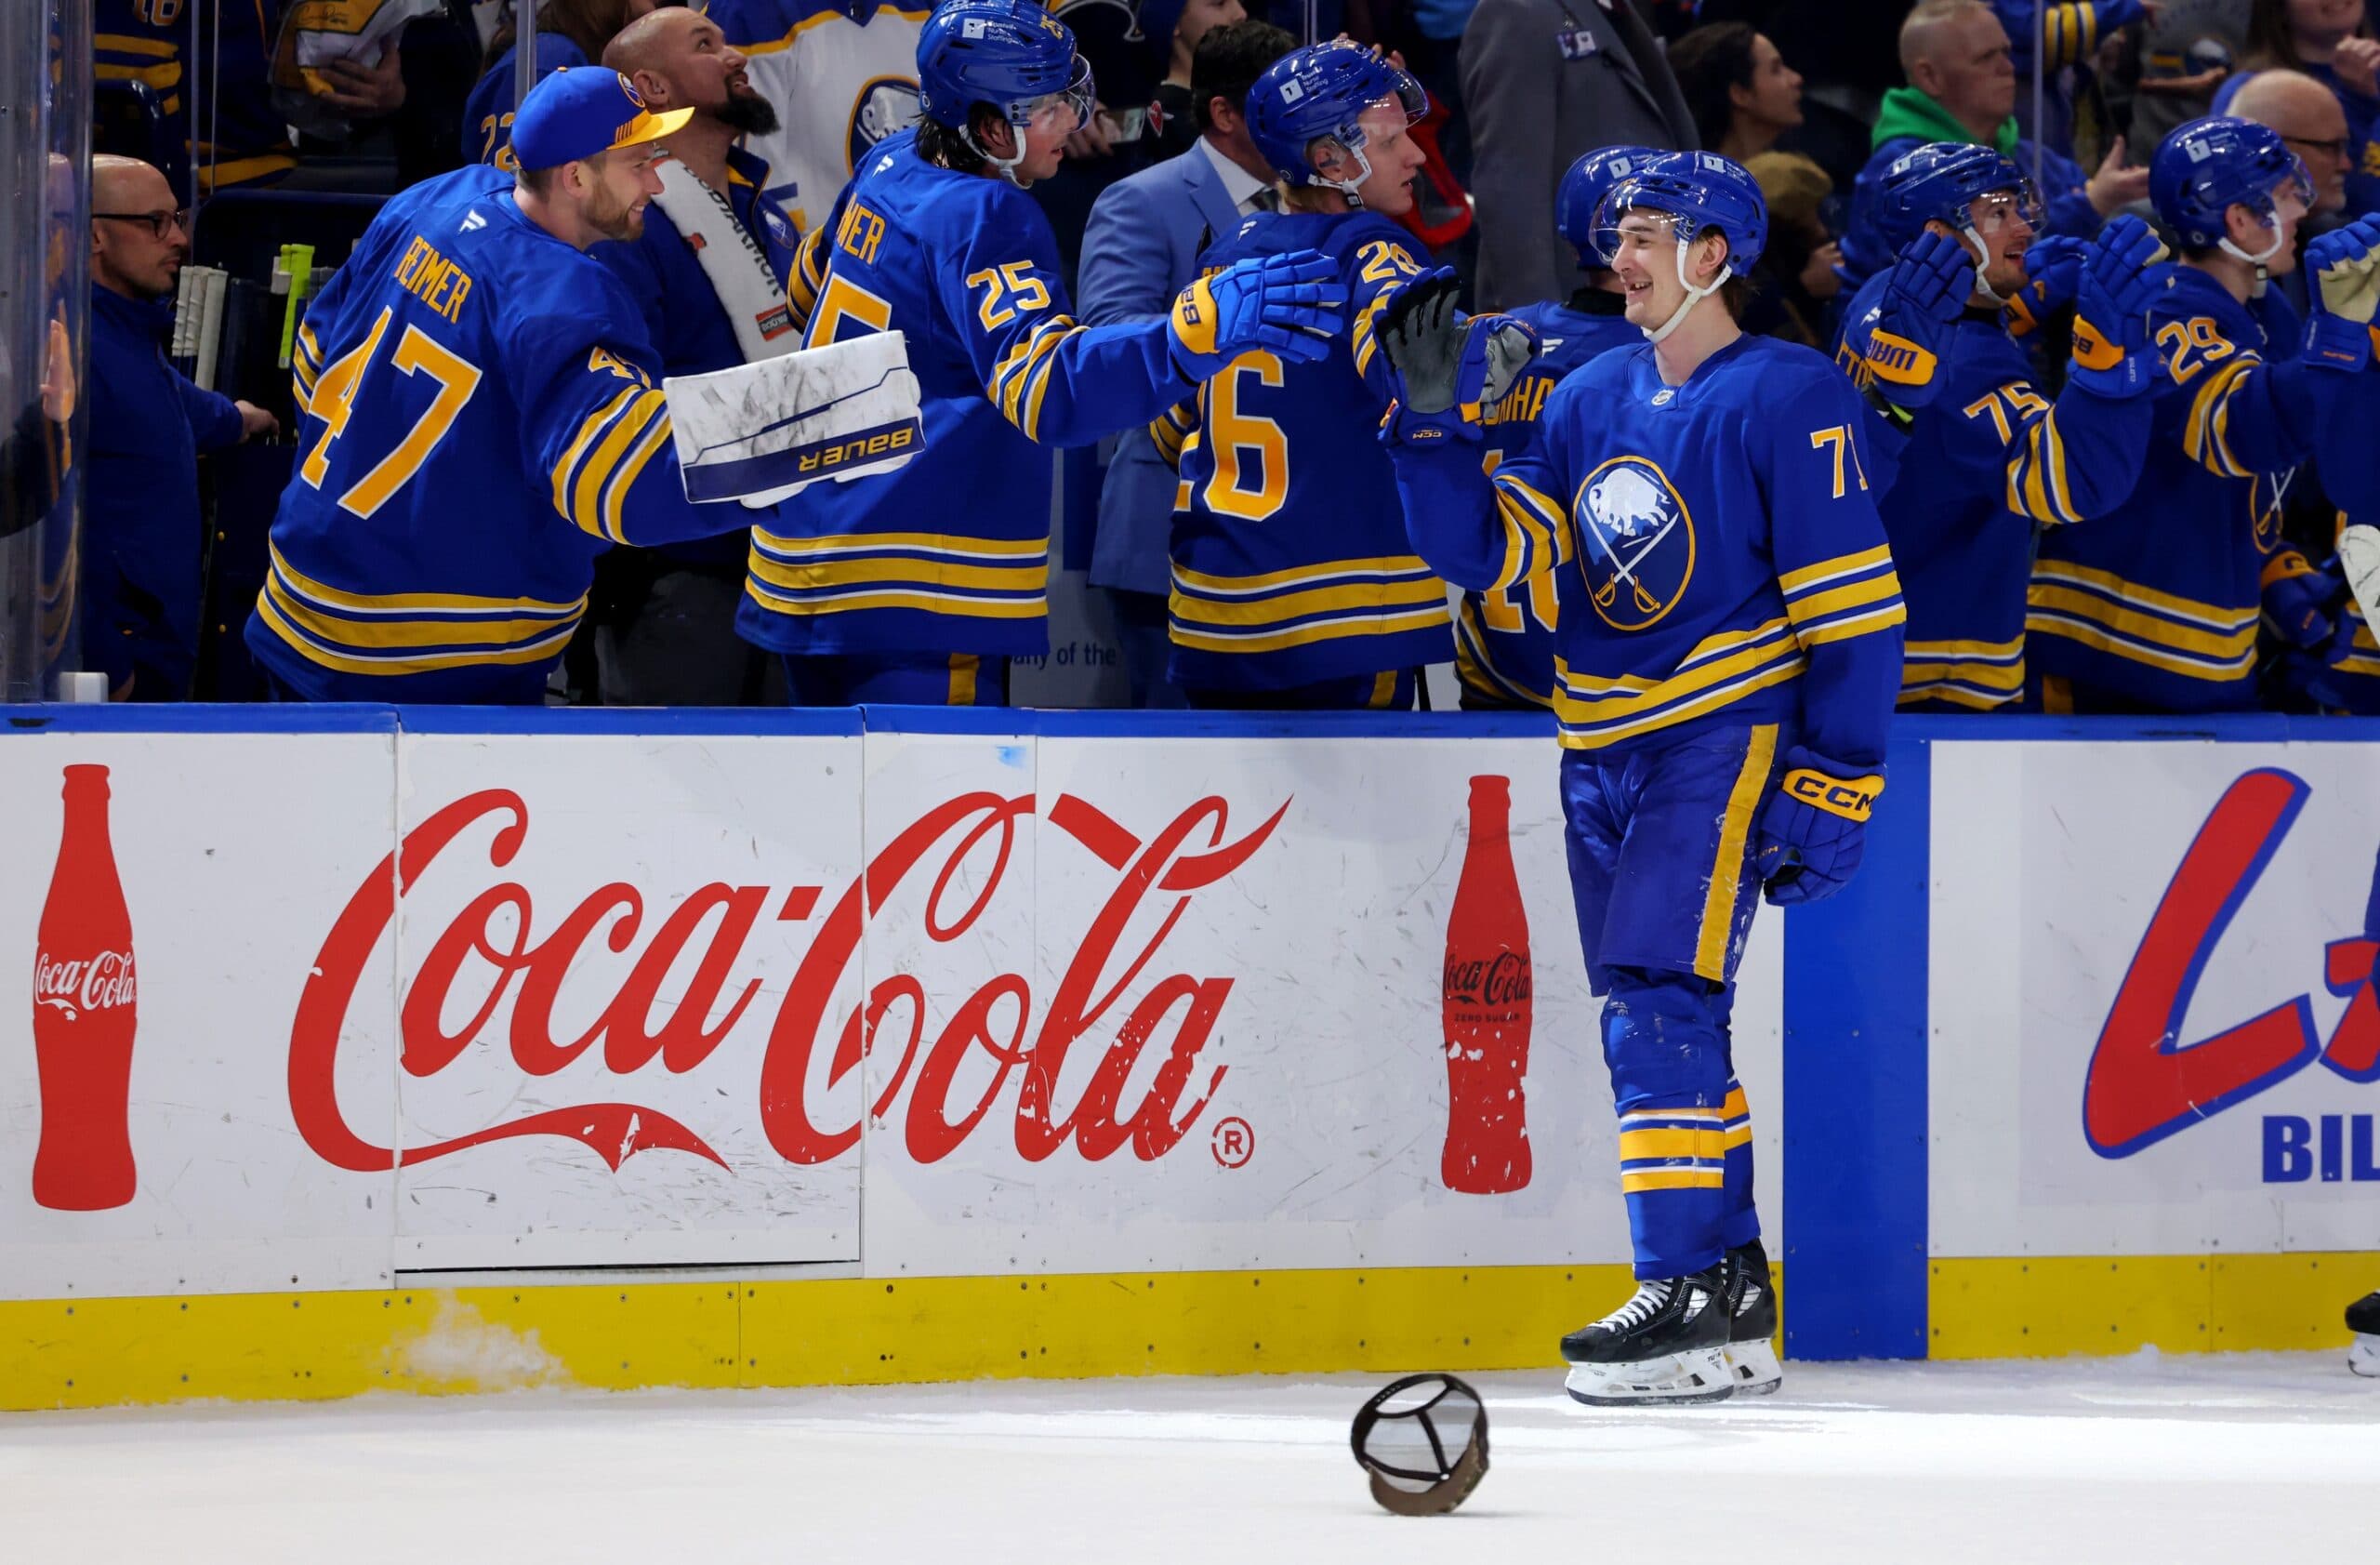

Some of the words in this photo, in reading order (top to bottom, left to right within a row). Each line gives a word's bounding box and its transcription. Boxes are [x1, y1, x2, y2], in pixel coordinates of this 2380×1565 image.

[393, 235, 472, 325] REIMER
[966, 259, 1052, 334] 25
[2156, 316, 2236, 386] 29
[300, 304, 483, 520] 47
[1173, 348, 1290, 523] 6
[1963, 380, 2050, 447] 75
[799, 427, 914, 472] BAUER
[1056, 642, 1076, 665] of
[1084, 642, 1116, 665] the
[1793, 776, 1877, 812] CCM
[35, 949, 135, 1012] Coca-Cola
[287, 788, 1295, 1173] Coca-Cola
[1443, 951, 1529, 1006] Coca-Cola
[1455, 1013, 1482, 1022] ZERO
[1486, 1013, 1520, 1022] SUGAR
